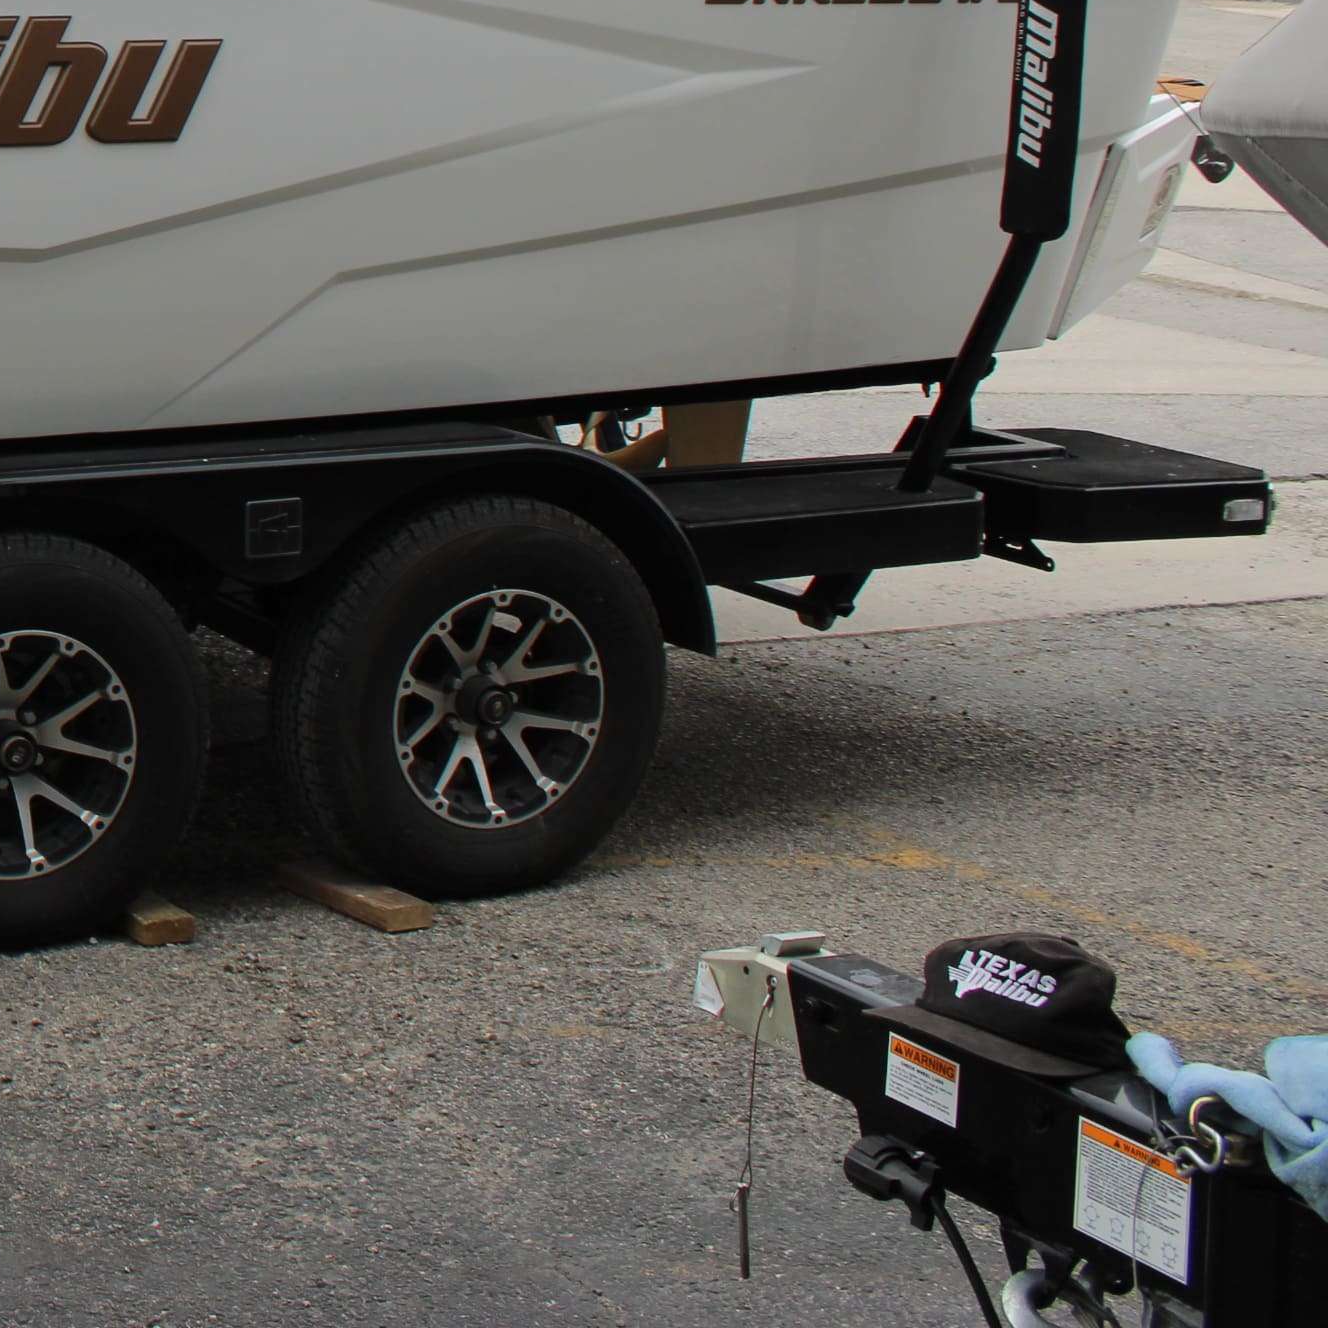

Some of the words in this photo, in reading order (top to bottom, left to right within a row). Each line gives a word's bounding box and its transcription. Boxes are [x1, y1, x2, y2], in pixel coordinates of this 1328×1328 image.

[965, 967, 1049, 1007] Malibu
[975, 949, 1057, 994] TEXAS
[904, 1047, 955, 1079] WARNING
